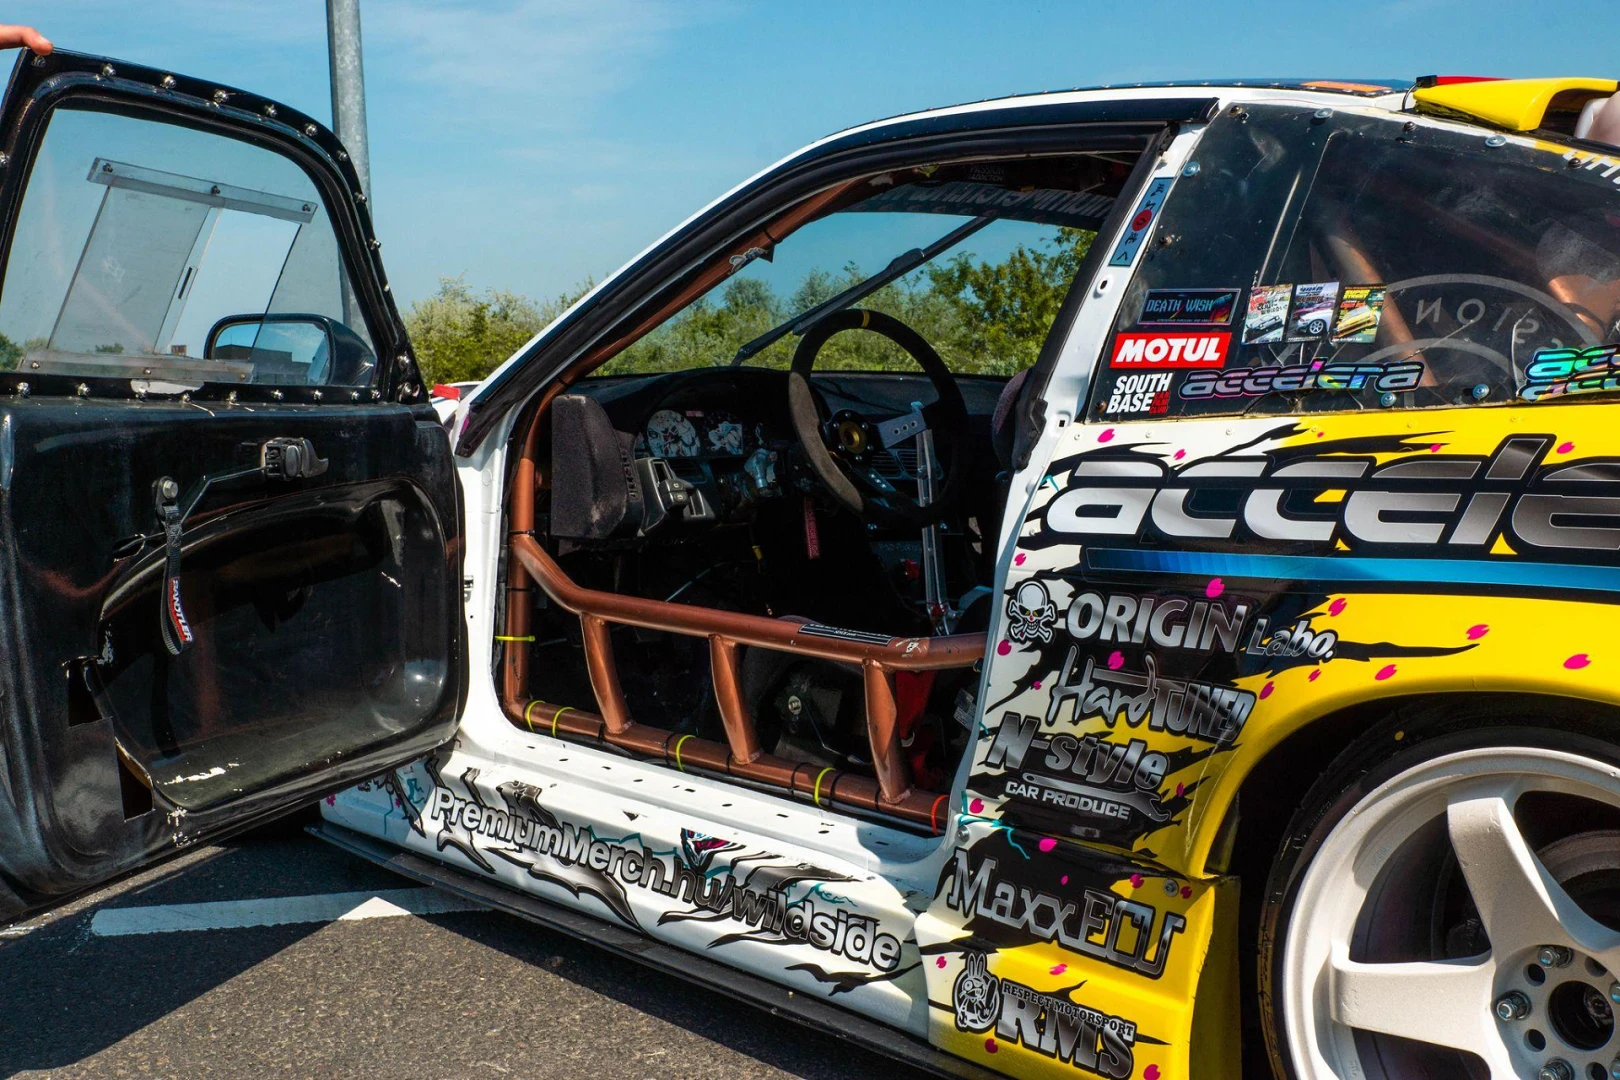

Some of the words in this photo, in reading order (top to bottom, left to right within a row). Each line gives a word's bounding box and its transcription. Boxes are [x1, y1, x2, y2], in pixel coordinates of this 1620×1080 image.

[1145, 299, 1182, 313] DEATH
[1186, 299, 1214, 312] WISH
[1115, 337, 1221, 363] MOTUL
[1113, 372, 1174, 395] SOUTH
[1181, 357, 1424, 398] accelera
[1105, 392, 1156, 414] BASE
[1067, 592, 1248, 652] ORIGIN
[1247, 617, 1337, 659] Labo.
[987, 714, 1168, 789] N-style
[1005, 781, 1039, 800] CAR
[1042, 791, 1131, 820] PRODUCE
[430, 784, 901, 972] PremiumMerch.hu/wildside
[951, 850, 1185, 976] MaxxECU
[1002, 982, 1052, 1009] RESPECT
[1053, 1000, 1134, 1037] MOTORSPORT
[996, 993, 1132, 1079] RMS
